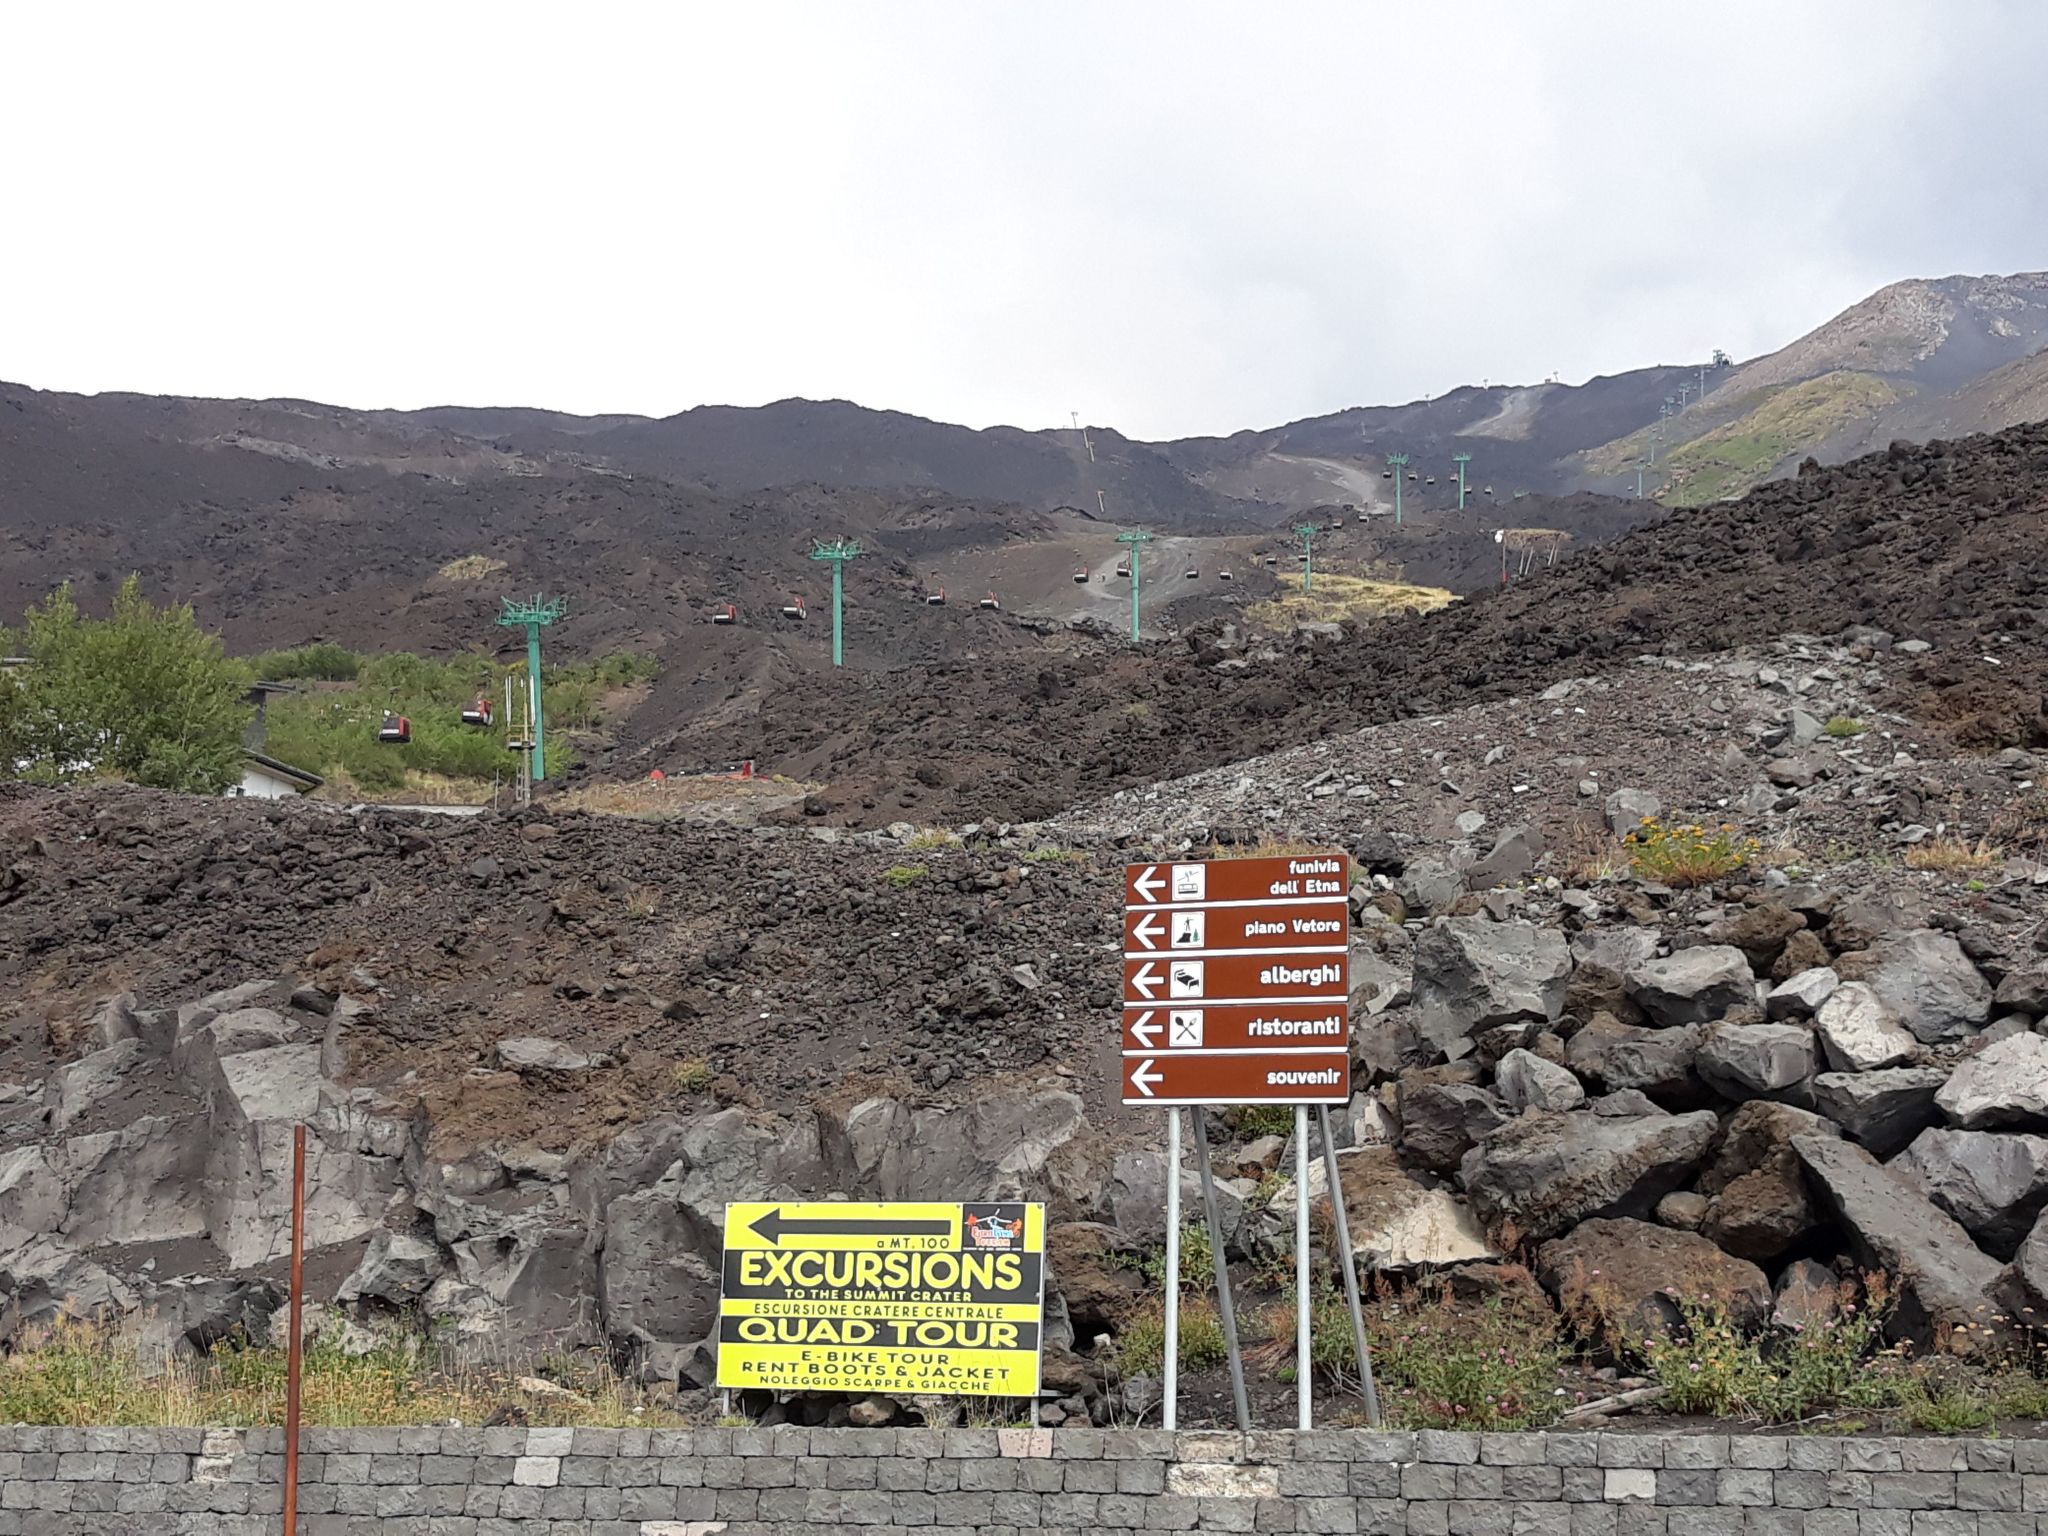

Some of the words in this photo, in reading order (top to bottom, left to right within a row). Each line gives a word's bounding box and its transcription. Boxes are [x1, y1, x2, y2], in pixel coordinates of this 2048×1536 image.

[1289, 859, 1340, 874] funivia
[1305, 879, 1340, 893] Etna
[1245, 922, 1286, 937] piano
[1292, 919, 1340, 933] Vetore
[1260, 964, 1340, 986] alberghi
[1248, 1017, 1340, 1036] ristoranti
[1267, 1068, 1341, 1084] souvenir
[920, 1238, 950, 1249] 100
[739, 1250, 1022, 1291] EXCURSIONS
[785, 1288, 805, 1299] TO
[810, 1289, 839, 1300] THE
[844, 1289, 906, 1301] SUMMIT
[911, 1291, 972, 1302] CRATER
[754, 1303, 848, 1316] ESCURSIONE
[853, 1305, 919, 1317] CRATERE
[925, 1307, 1004, 1319] CENTRALE
[738, 1317, 875, 1343] QUAD
[887, 1320, 1019, 1348] TOUR
[801, 1350, 878, 1363] E-BIKE
[887, 1352, 950, 1365] TOUR
[742, 1361, 799, 1373] RENT
[808, 1363, 886, 1376] BOOTS
[895, 1366, 908, 1376] &
[916, 1367, 1010, 1380] JACKET
[759, 1375, 838, 1386] NOLEGGIO
[844, 1377, 901, 1388] SCARPE
[907, 1379, 915, 1388] &
[921, 1380, 991, 1391] GIACCHE
